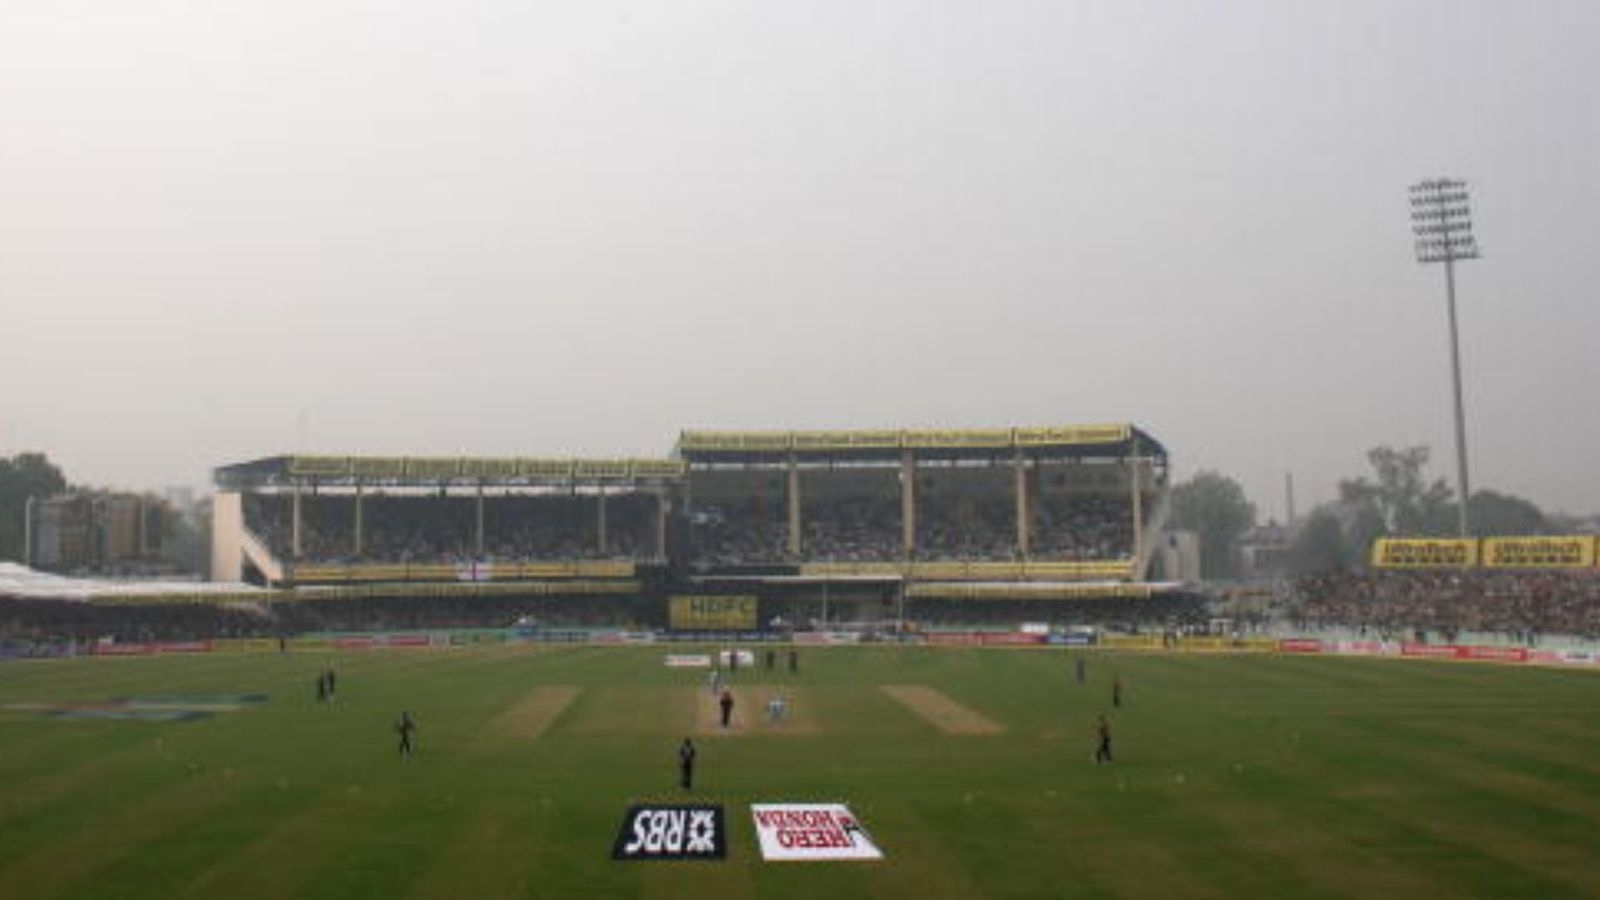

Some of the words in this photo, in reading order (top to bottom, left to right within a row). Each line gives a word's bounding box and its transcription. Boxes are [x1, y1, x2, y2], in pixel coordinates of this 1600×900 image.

[755, 810, 834, 829] HONDA
[624, 809, 686, 854] RBS
[776, 829, 854, 848] HERO
